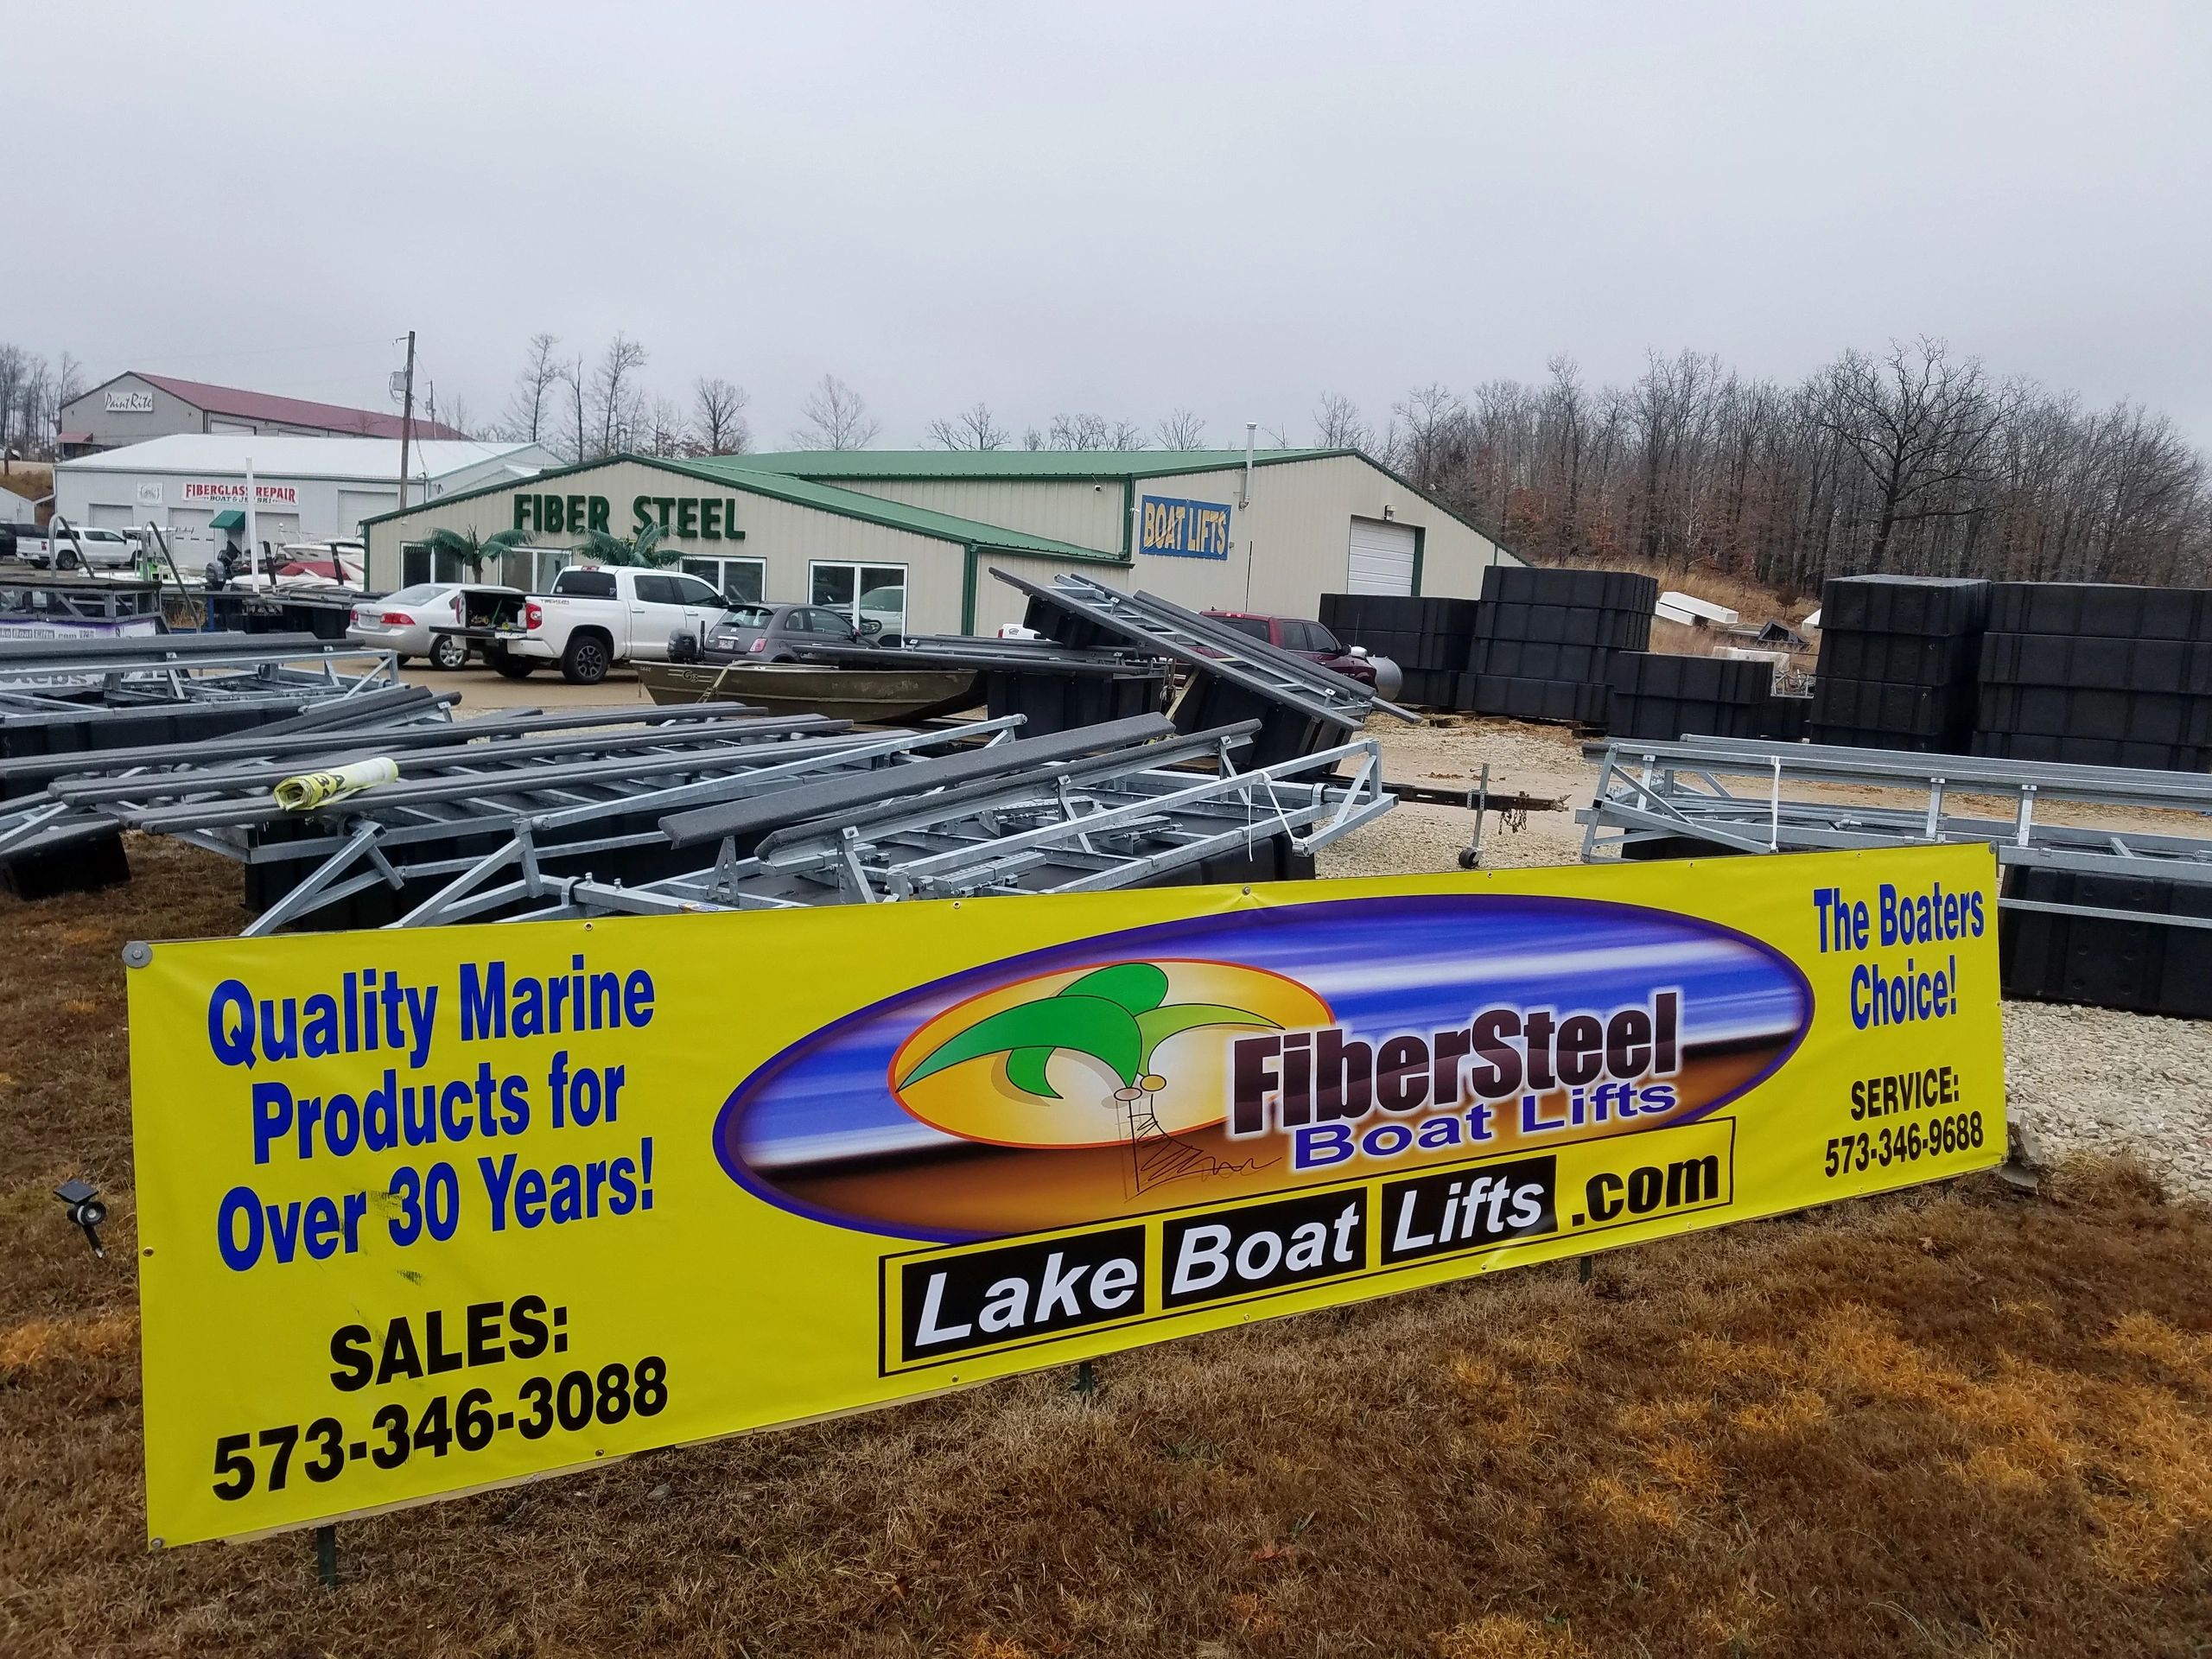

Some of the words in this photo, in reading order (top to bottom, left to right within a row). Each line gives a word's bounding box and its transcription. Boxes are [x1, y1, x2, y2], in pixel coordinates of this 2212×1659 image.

[255, 486, 296, 504] REPAIR
[513, 494, 610, 535] FIBER
[632, 495, 746, 539] STEEL
[1144, 502, 1185, 550] BOAT
[1187, 507, 1227, 556] LIFTS
[1814, 887, 1869, 953] The
[1879, 882, 1985, 947] Boaters
[208, 968, 438, 1070] Quality
[460, 954, 655, 1042] Marine
[1851, 955, 1957, 1031] Choice!
[1233, 991, 1678, 1135] FiberSteel
[1851, 1066, 1960, 1121] SERVICE:
[251, 1063, 531, 1165] Products
[548, 1051, 626, 1128] for
[1296, 1104, 1492, 1169] Boat
[1522, 1082, 1676, 1134] Lifts
[1825, 1110, 1984, 1178] 573-346-9688
[217, 1186, 366, 1271] Over
[388, 1162, 459, 1247] 30
[477, 1137, 654, 1232] Years!
[915, 1252, 1138, 1347] Lake
[1171, 1202, 1360, 1295] Boat
[1392, 1175, 1545, 1253] Lifts
[1572, 1154, 1719, 1227] .com
[330, 1294, 569, 1392] SALES:
[213, 1356, 668, 1502] 573-346-3088
